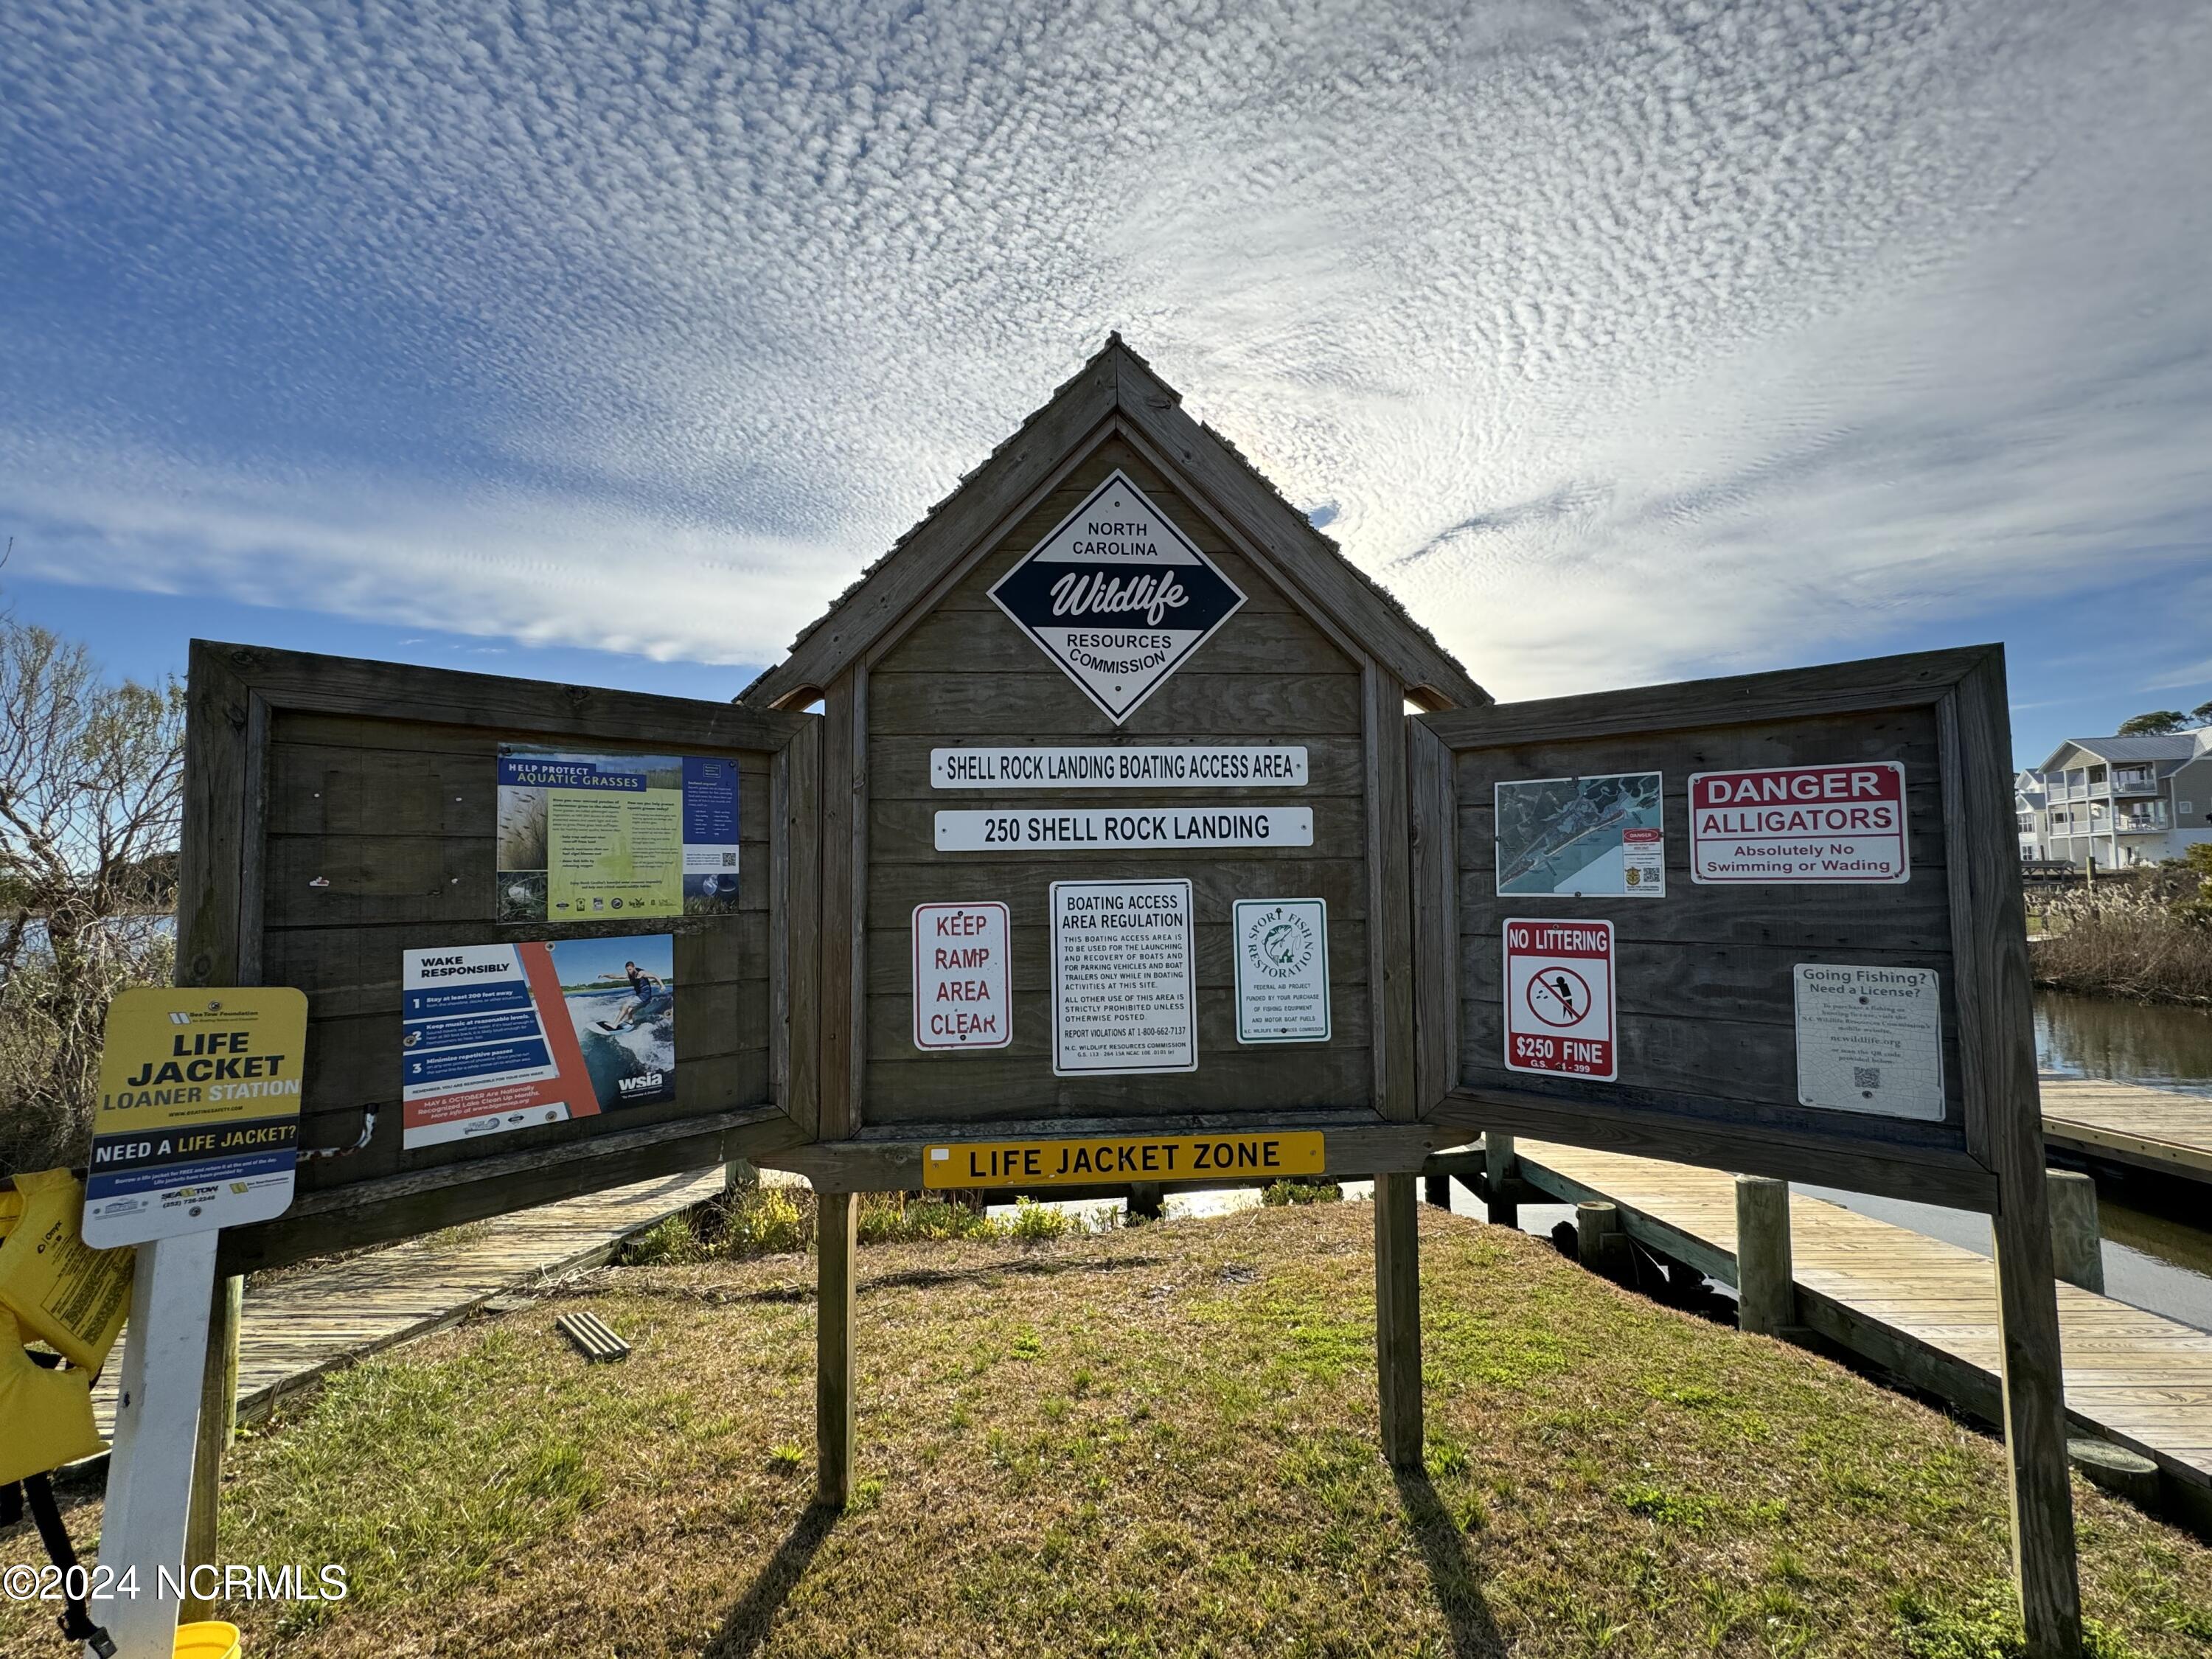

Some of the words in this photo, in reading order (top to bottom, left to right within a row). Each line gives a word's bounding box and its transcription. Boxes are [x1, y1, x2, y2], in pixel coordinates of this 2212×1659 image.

[1088, 523, 1147, 535] NORTH
[1073, 542, 1158, 555] CAROLINA
[1050, 570, 1189, 626] Wildlife
[1067, 634, 1172, 648] RESOURCES
[1070, 649, 1166, 674] COMMISSION
[509, 764, 538, 773] HELP
[542, 766, 589, 775] PROTECT
[947, 756, 995, 779] SHELL
[1001, 756, 1043, 779] ROCK
[1048, 755, 1114, 779] LANDING
[1120, 755, 1185, 779] BOATING
[1189, 754, 1248, 778] ACCESS
[1253, 754, 1293, 778] AREA
[518, 773, 577, 785] AQUATIC
[582, 776, 638, 787] GRASSES
[1708, 771, 1882, 804] DANGER
[985, 818, 1020, 842] 250
[1028, 818, 1097, 841] SHELL
[1105, 816, 1167, 840] ROCK
[1175, 815, 1270, 839] LANDING
[1702, 807, 1892, 833] ALLIGATORS
[1734, 845, 1824, 858] Absolutely
[1830, 844, 1854, 855] No
[1708, 861, 1792, 873] Swimming
[1822, 860, 1890, 873] Wading
[1068, 896, 1123, 911] BOATING
[1128, 895, 1178, 909] ACCESS
[937, 916, 987, 936] KEEP
[1062, 915, 1096, 928] AREA
[1102, 914, 1183, 928] REGULATION
[1248, 911, 1281, 940] SPORT
[1288, 914, 1312, 936] FISH
[1510, 929, 1528, 949] NO
[1536, 930, 1607, 952] LITTERING
[421, 956, 463, 967] WAKE
[936, 947, 990, 970] RAMP
[1248, 941, 1313, 978] RESTORATION
[421, 964, 509, 978] RESPONSIBLY
[1804, 969, 1851, 984] Going
[1857, 971, 1927, 987] Fishing?
[936, 981, 990, 1002] AREA
[1810, 984, 1844, 993] Need
[1861, 986, 1921, 997] License?
[413, 998, 420, 1009] 1
[474, 1017, 509, 1025] reasonable
[931, 1014, 996, 1034] CLEAR
[1065, 1029, 1088, 1038] REPORT
[1091, 1028, 1126, 1037] VIOLATIONS
[1128, 1028, 1136, 1036] AT
[1138, 1026, 1186, 1036] 1-800-662-7137
[1831, 1035, 1901, 1047] ncwildlife.org
[173, 1032, 249, 1057] LIFE
[1517, 1036, 1554, 1058] $250
[1563, 1041, 1603, 1064] FINE
[413, 1063, 422, 1074] 3
[426, 1056, 458, 1064] Minimize
[459, 1052, 490, 1062] repetitive
[492, 1048, 513, 1057] passes
[1574, 1064, 1590, 1073] 399
[128, 1055, 285, 1087] JACKET
[619, 1072, 662, 1091] wsia
[103, 1088, 201, 1110] LOANER
[209, 1079, 299, 1102] STATION
[449, 1093, 484, 1103] OCTOBER
[500, 1085, 535, 1096] Nationally
[95, 1142, 150, 1163] NEED
[157, 1140, 171, 1155] A
[178, 1134, 215, 1152] LIFE
[221, 1125, 296, 1147] JACKET?
[970, 1150, 1042, 1178] LIFE
[1056, 1144, 1179, 1175] JACKET
[1193, 1141, 1280, 1169] ZONE
[161, 1192, 181, 1200] SEA
[195, 1186, 218, 1194] TOW
[163, 1200, 181, 1208] (252)
[45, 1220, 62, 1240] Onyx
